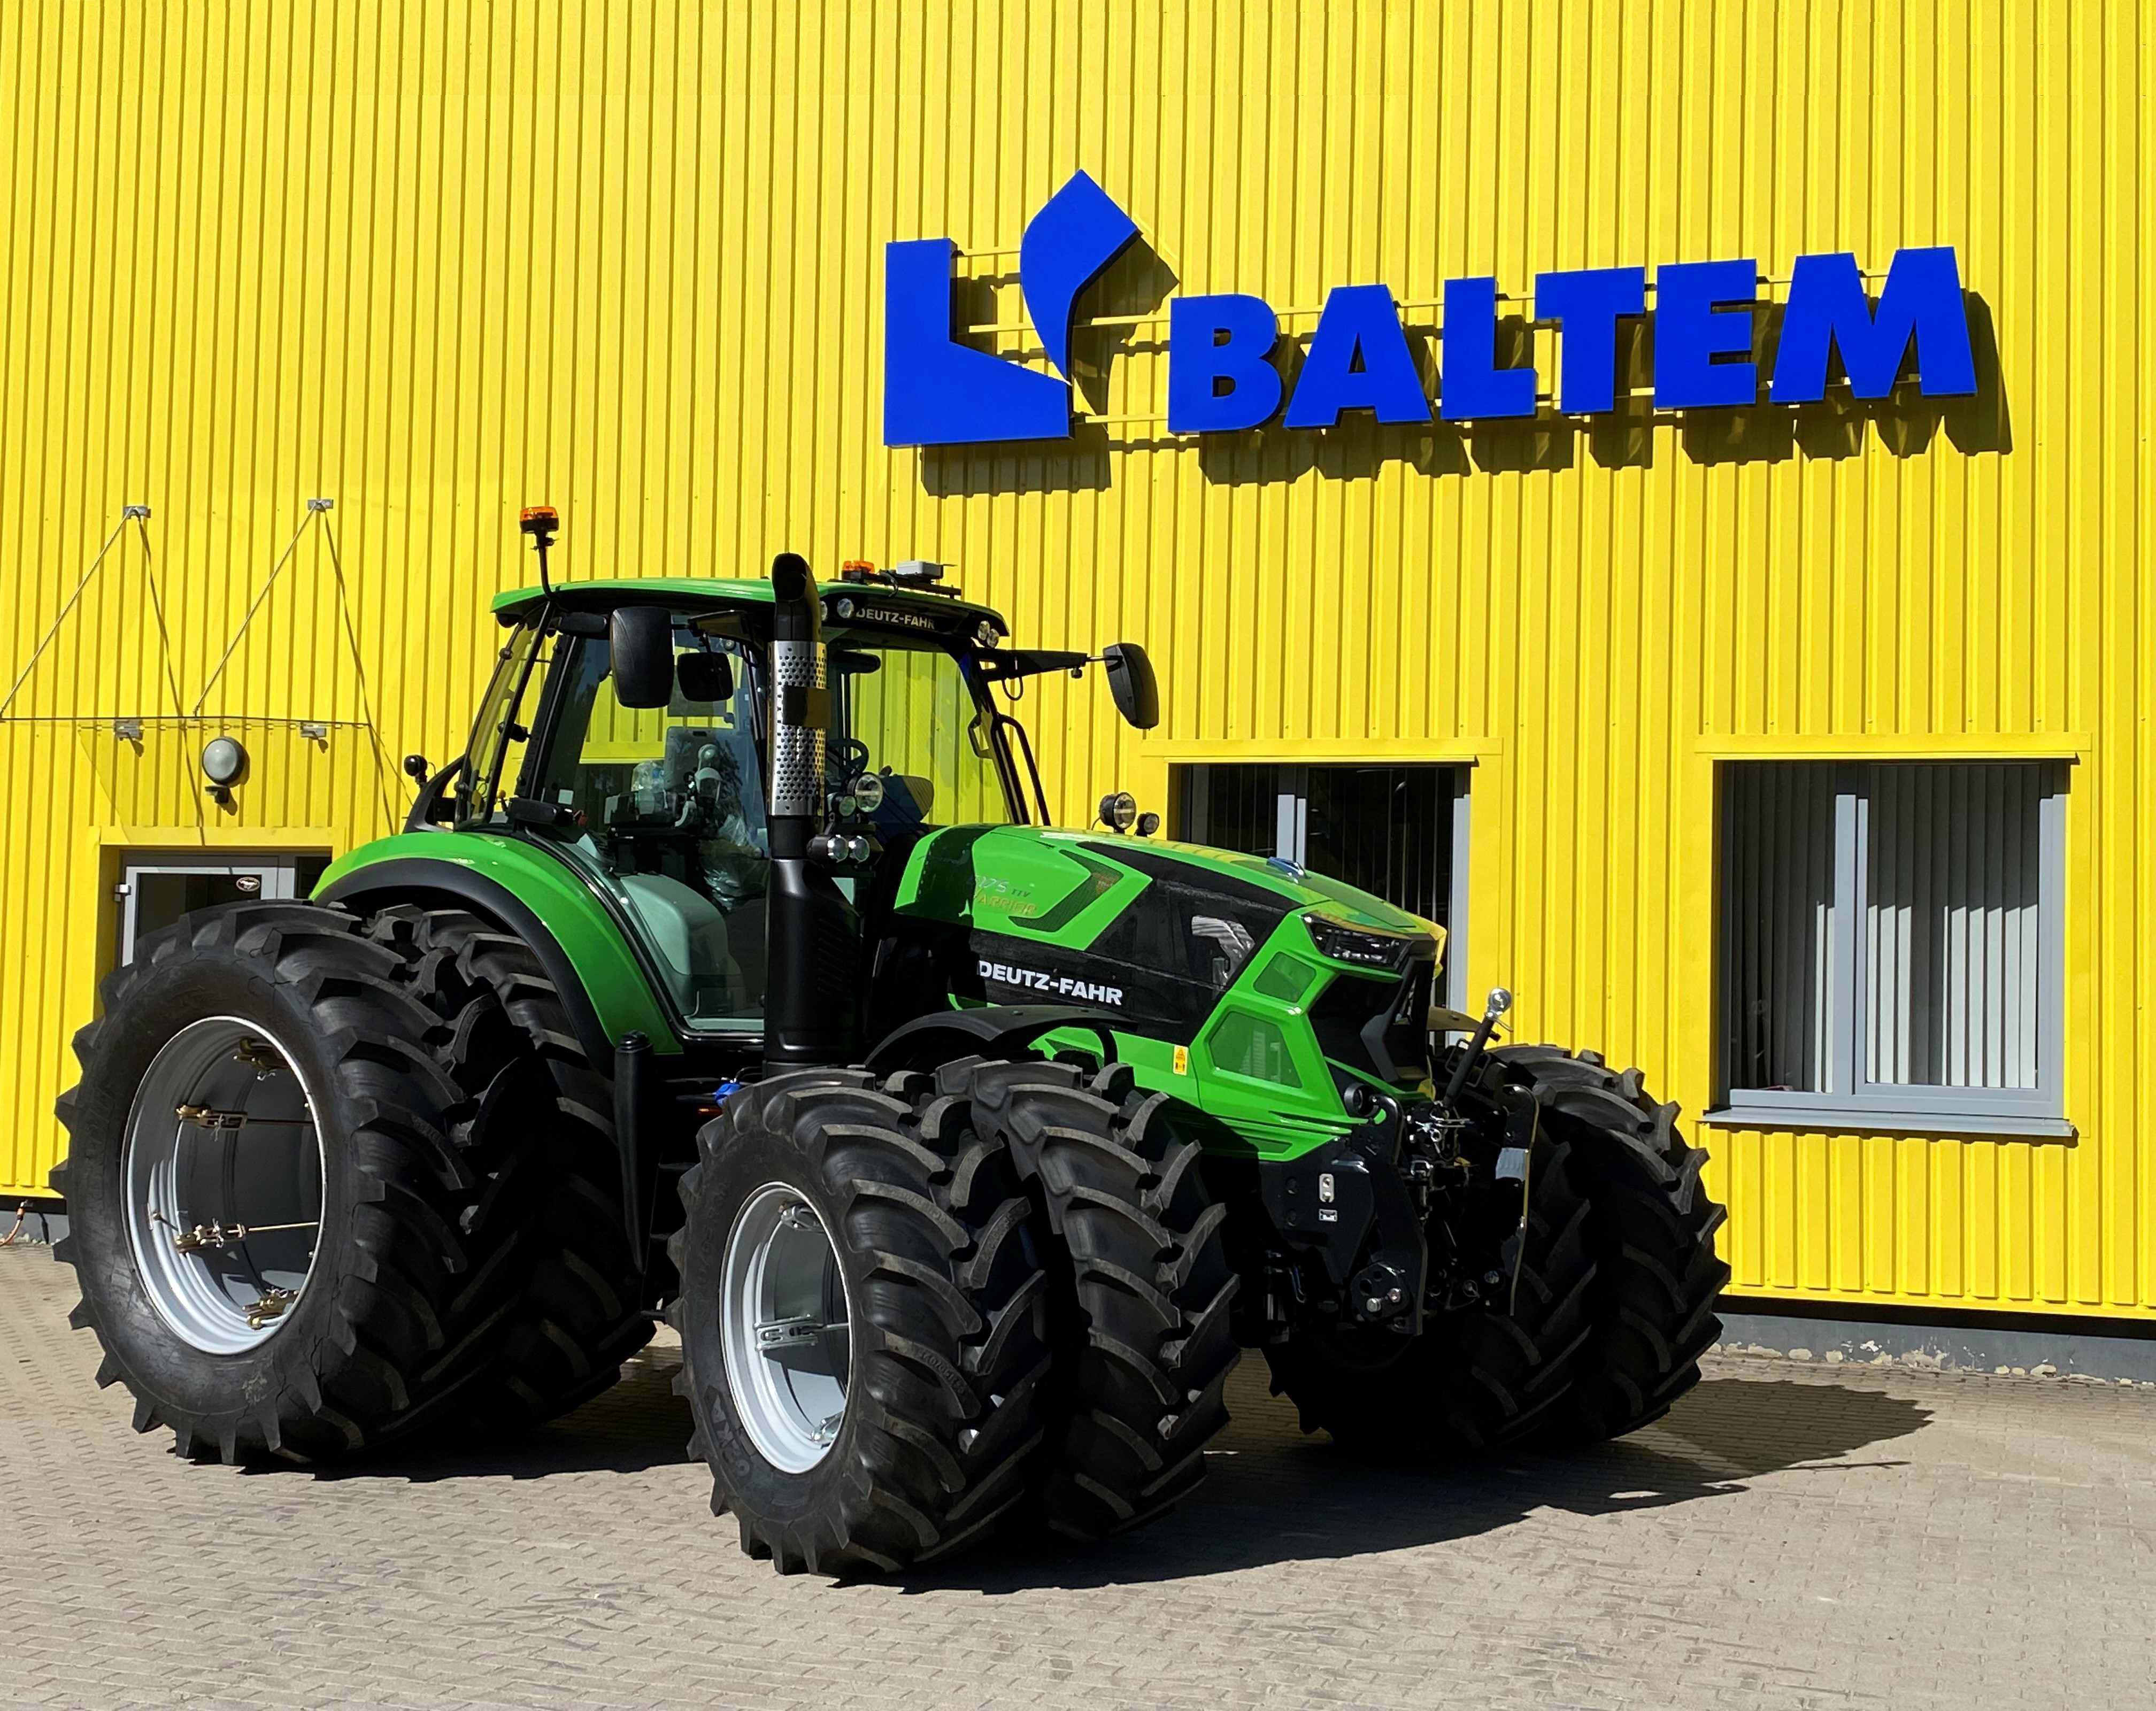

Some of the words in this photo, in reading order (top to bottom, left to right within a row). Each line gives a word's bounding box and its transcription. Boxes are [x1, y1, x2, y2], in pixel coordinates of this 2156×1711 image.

[1168, 246, 1977, 434] BALTEM
[856, 608, 935, 629] DEUTZ-FAHR
[977, 960, 1123, 1006] DEUTZ-FAHR
